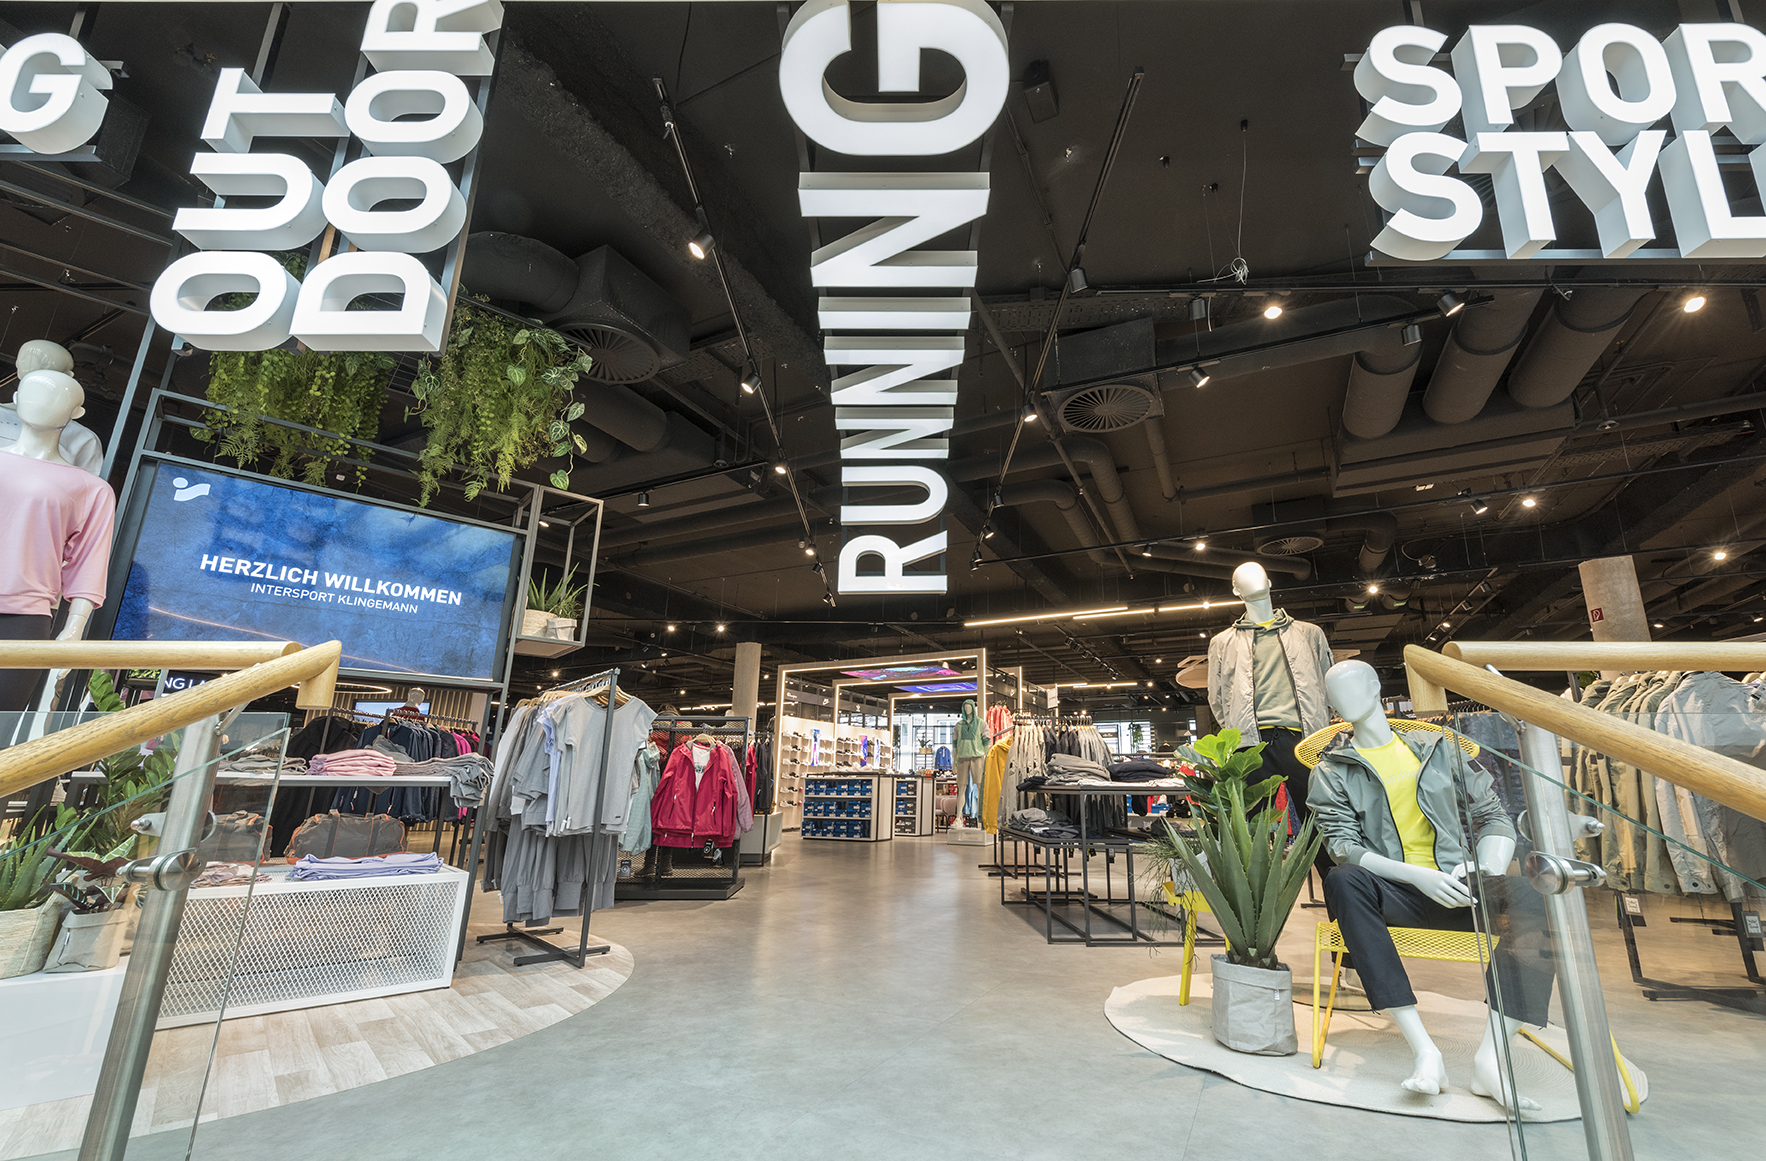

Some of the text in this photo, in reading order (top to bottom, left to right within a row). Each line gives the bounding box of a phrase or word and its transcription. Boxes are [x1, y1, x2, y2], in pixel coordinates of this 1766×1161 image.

[150, 67, 340, 341] OUT
[289, 0, 492, 341] DOOR
[779, 0, 1010, 593] RUNNING
[199, 553, 462, 606] HERZLICH WILLKOMMEN
[250, 582, 418, 614] INTERSPORT KLINGEMANN
